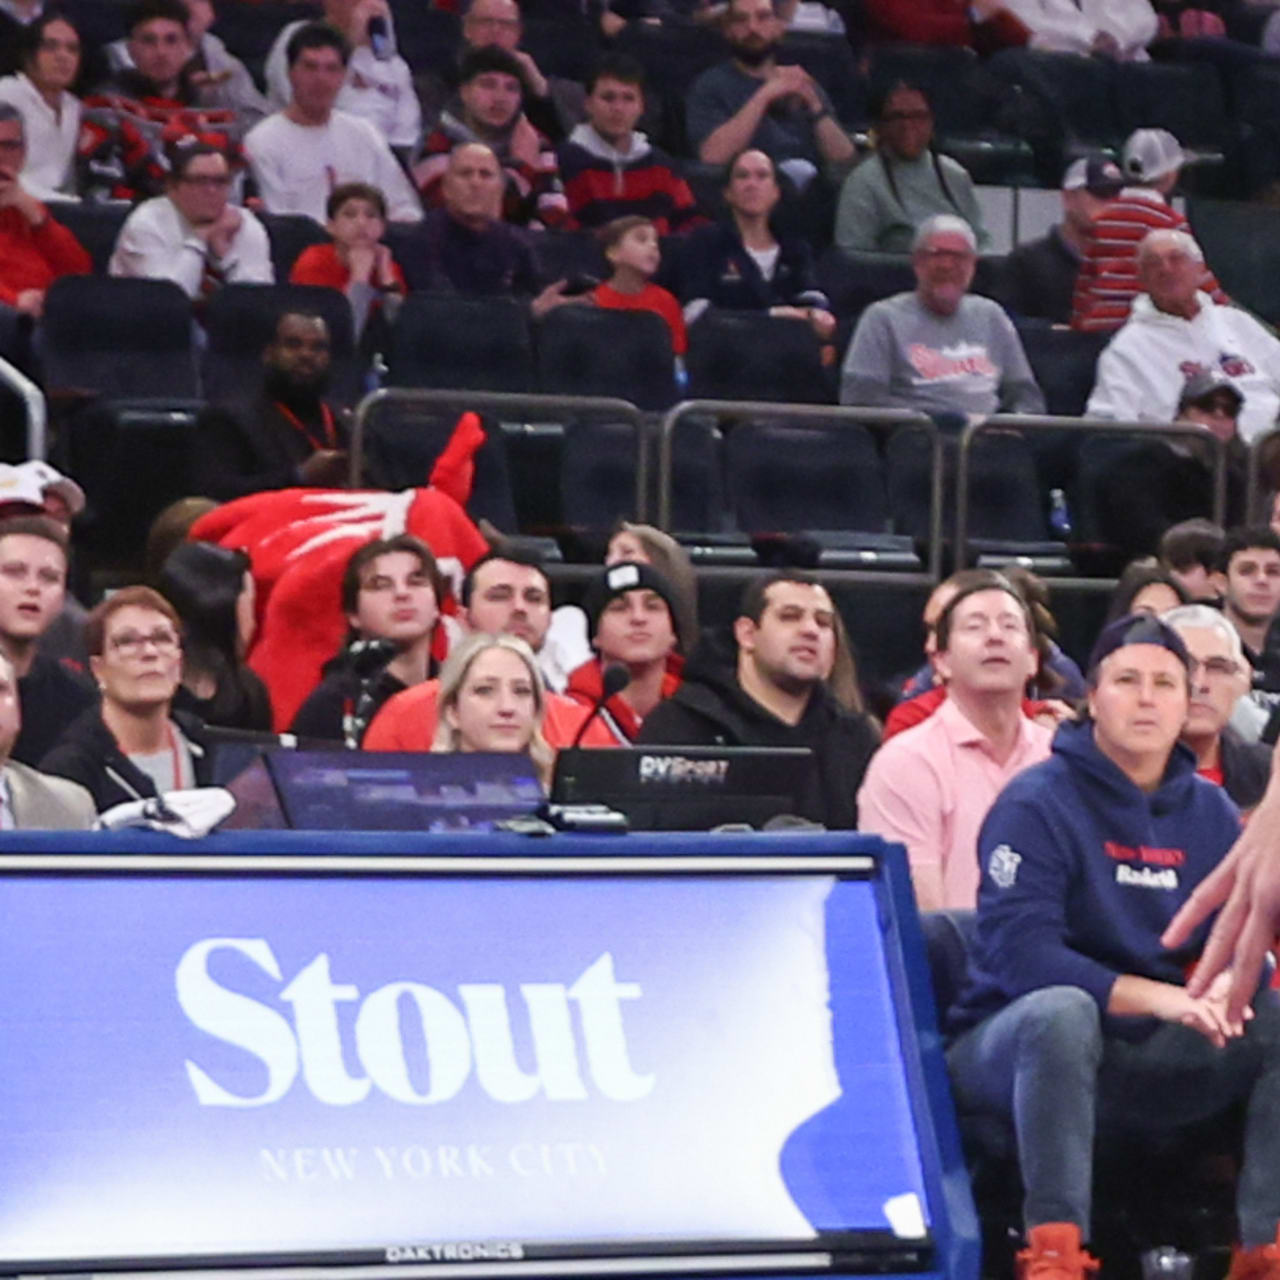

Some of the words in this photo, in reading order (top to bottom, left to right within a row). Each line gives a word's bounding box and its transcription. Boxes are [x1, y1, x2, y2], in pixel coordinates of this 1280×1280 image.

[175, 938, 655, 1108] Stout
[259, 1147, 358, 1183] NEW
[373, 1144, 496, 1180] YORK
[508, 1142, 609, 1178] CITY
